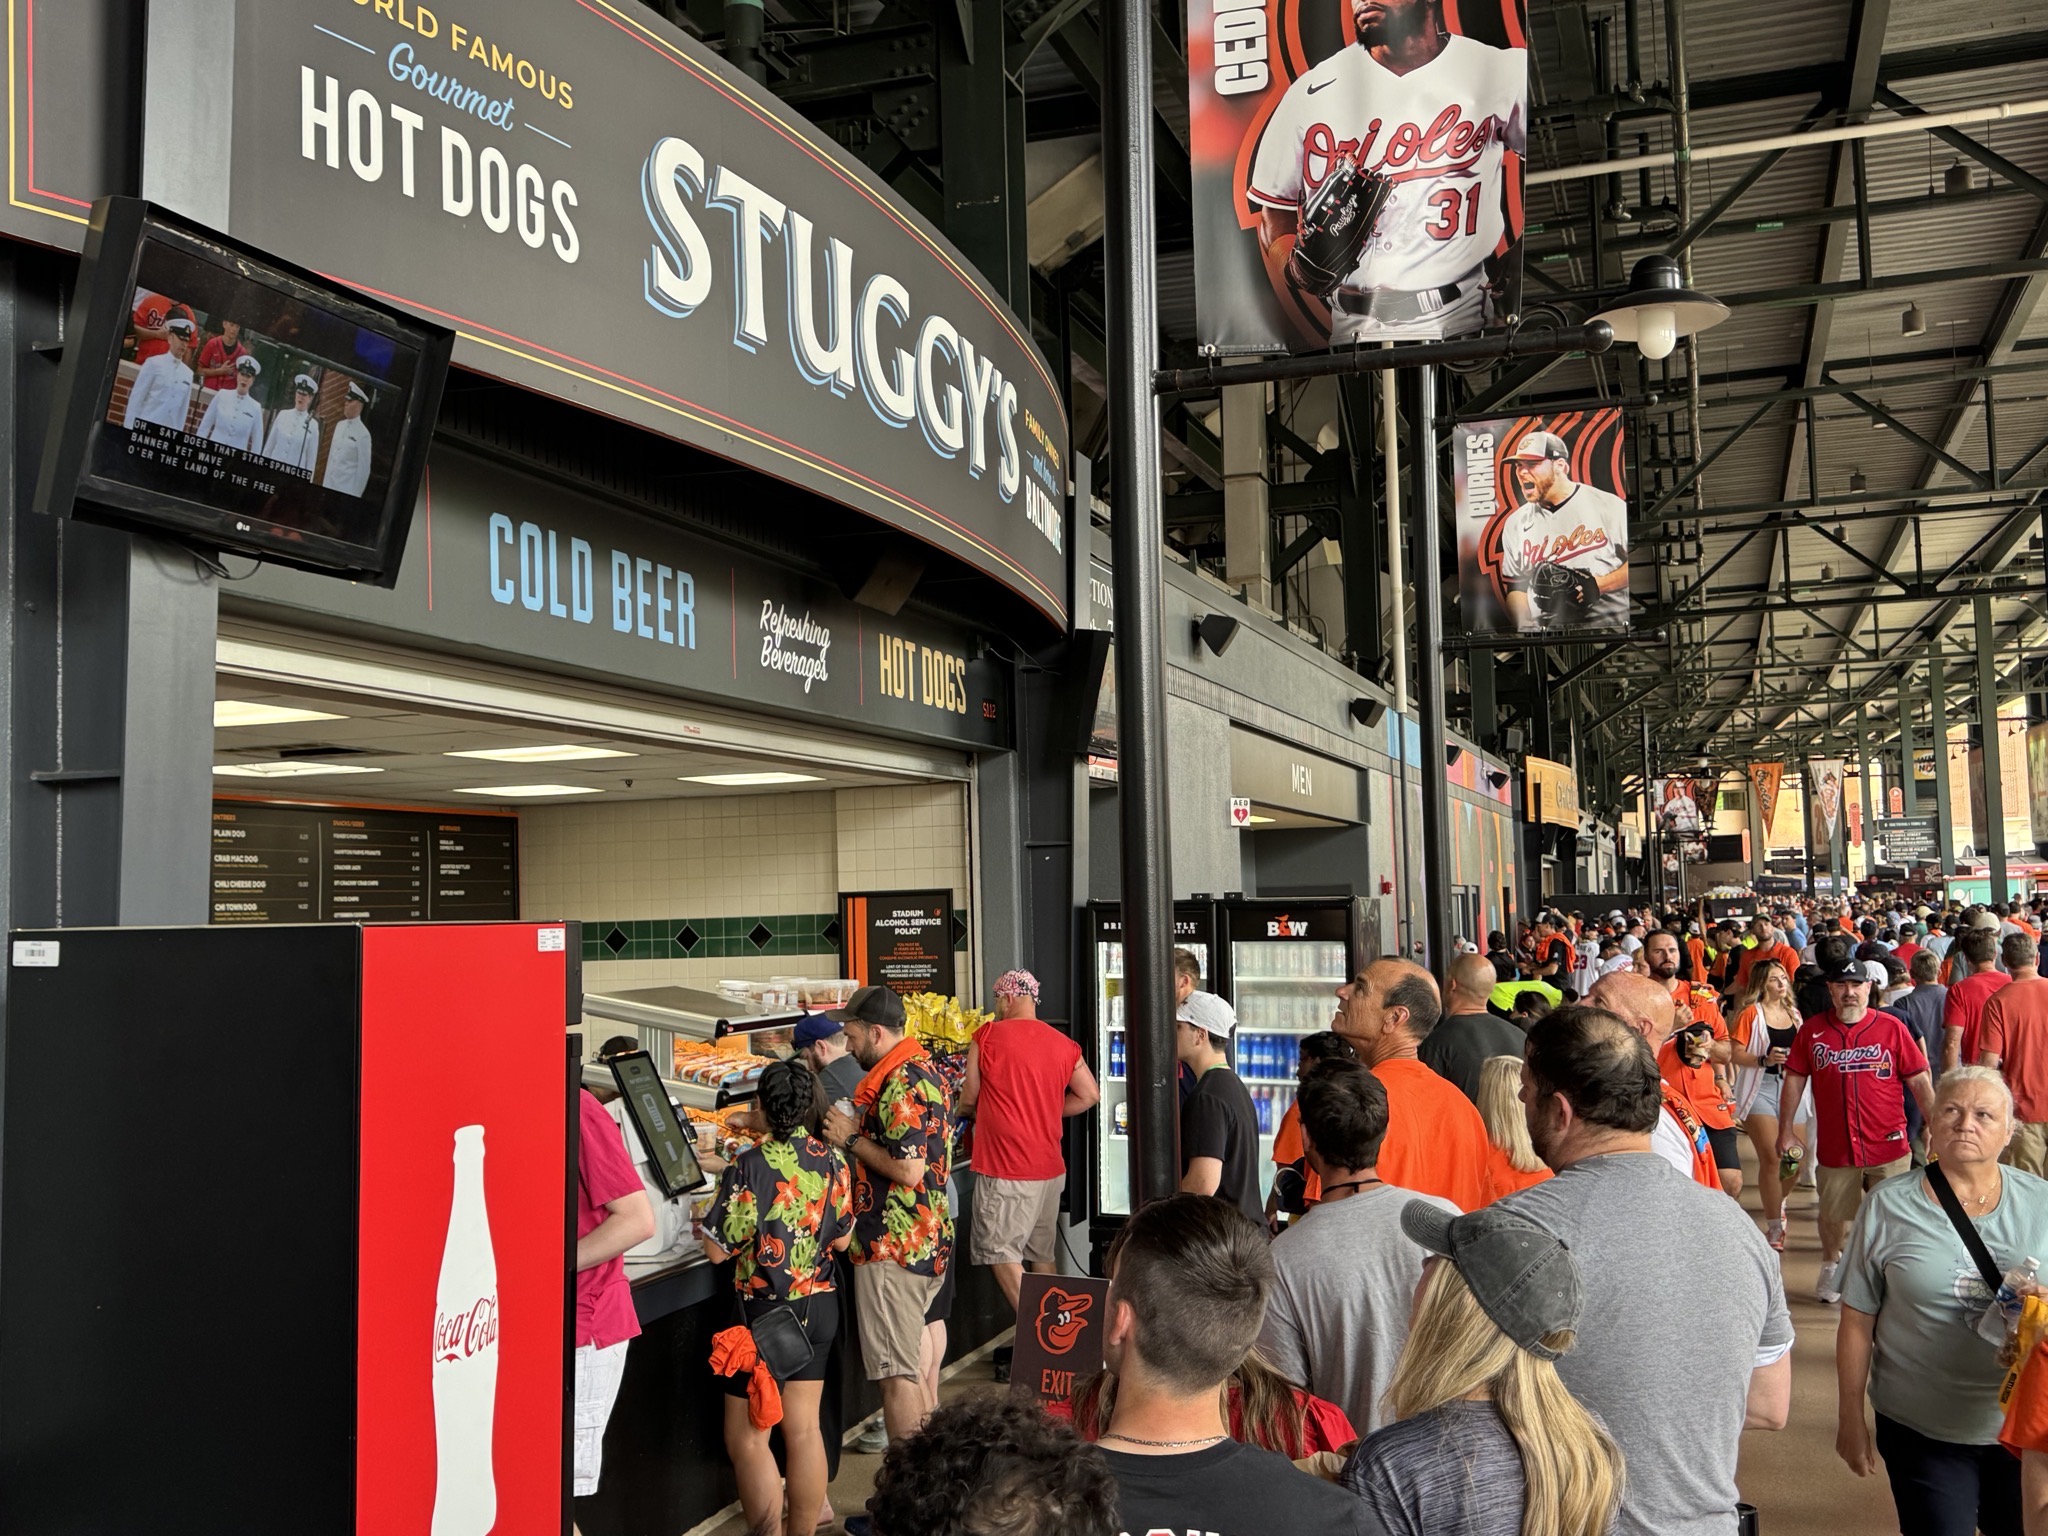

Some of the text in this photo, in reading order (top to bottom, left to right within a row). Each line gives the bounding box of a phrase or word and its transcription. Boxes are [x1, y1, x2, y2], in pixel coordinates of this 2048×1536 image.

[451, 23, 573, 109] FAMOUS
[1214, 0, 1269, 95] CED
[388, 42, 515, 131] Gourmet
[301, 65, 580, 264] HOT DOGS
[1303, 104, 1495, 189] Orioles
[1424, 182, 1481, 240] 31
[147, 308, 166, 328] Ori
[641, 137, 1019, 504] STUGGY'S
[130, 432, 222, 466] BANNER YET WAVE
[134, 420, 312, 480] OH, SAY DOES THAT STAR-SPANGLED
[1026, 408, 1044, 446] FAMILY
[128, 445, 276, 494] O'ER THE LAND OF THE FREE
[1466, 433, 1497, 518] BURNES
[1026, 474, 1062, 556] BALTIMORE
[1522, 524, 1609, 565] Orioles
[489, 512, 697, 650] COLD BEER
[758, 599, 831, 659] Refreshing
[760, 635, 830, 694] Beverages
[878, 633, 967, 715] HOT DOGS
[1291, 762, 1312, 797] MEN
[214, 829, 246, 838] PLAIN DOG
[244, 855, 259, 863] DOG
[875, 918, 941, 927] ALCOHOL SERVICE
[892, 910, 924, 918] STADIUM
[1267, 919, 1308, 936] B&W
[1812, 1042, 1882, 1070] Braves
[435, 1294, 496, 1363] Coca-Cola
[1041, 1368, 1076, 1396] EXIT
